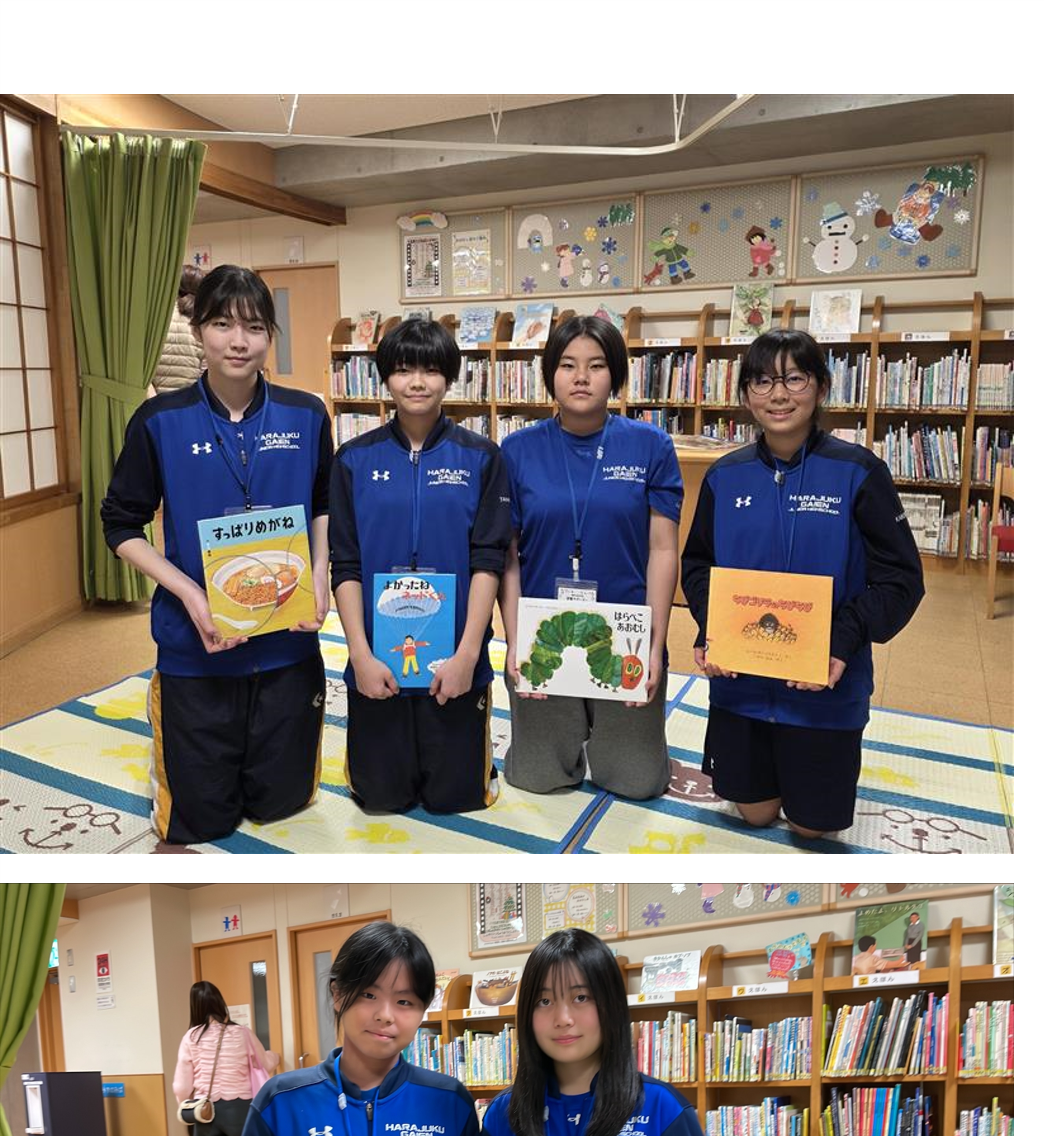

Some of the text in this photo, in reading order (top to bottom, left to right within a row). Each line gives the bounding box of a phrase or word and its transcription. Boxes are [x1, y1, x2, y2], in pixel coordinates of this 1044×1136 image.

[213, 516, 295, 541] すっぱりめがね
[384, 580, 430, 590] よかったね
[616, 622, 646, 634] あおむし
[385, 1123, 445, 1134] HARAJUKU
